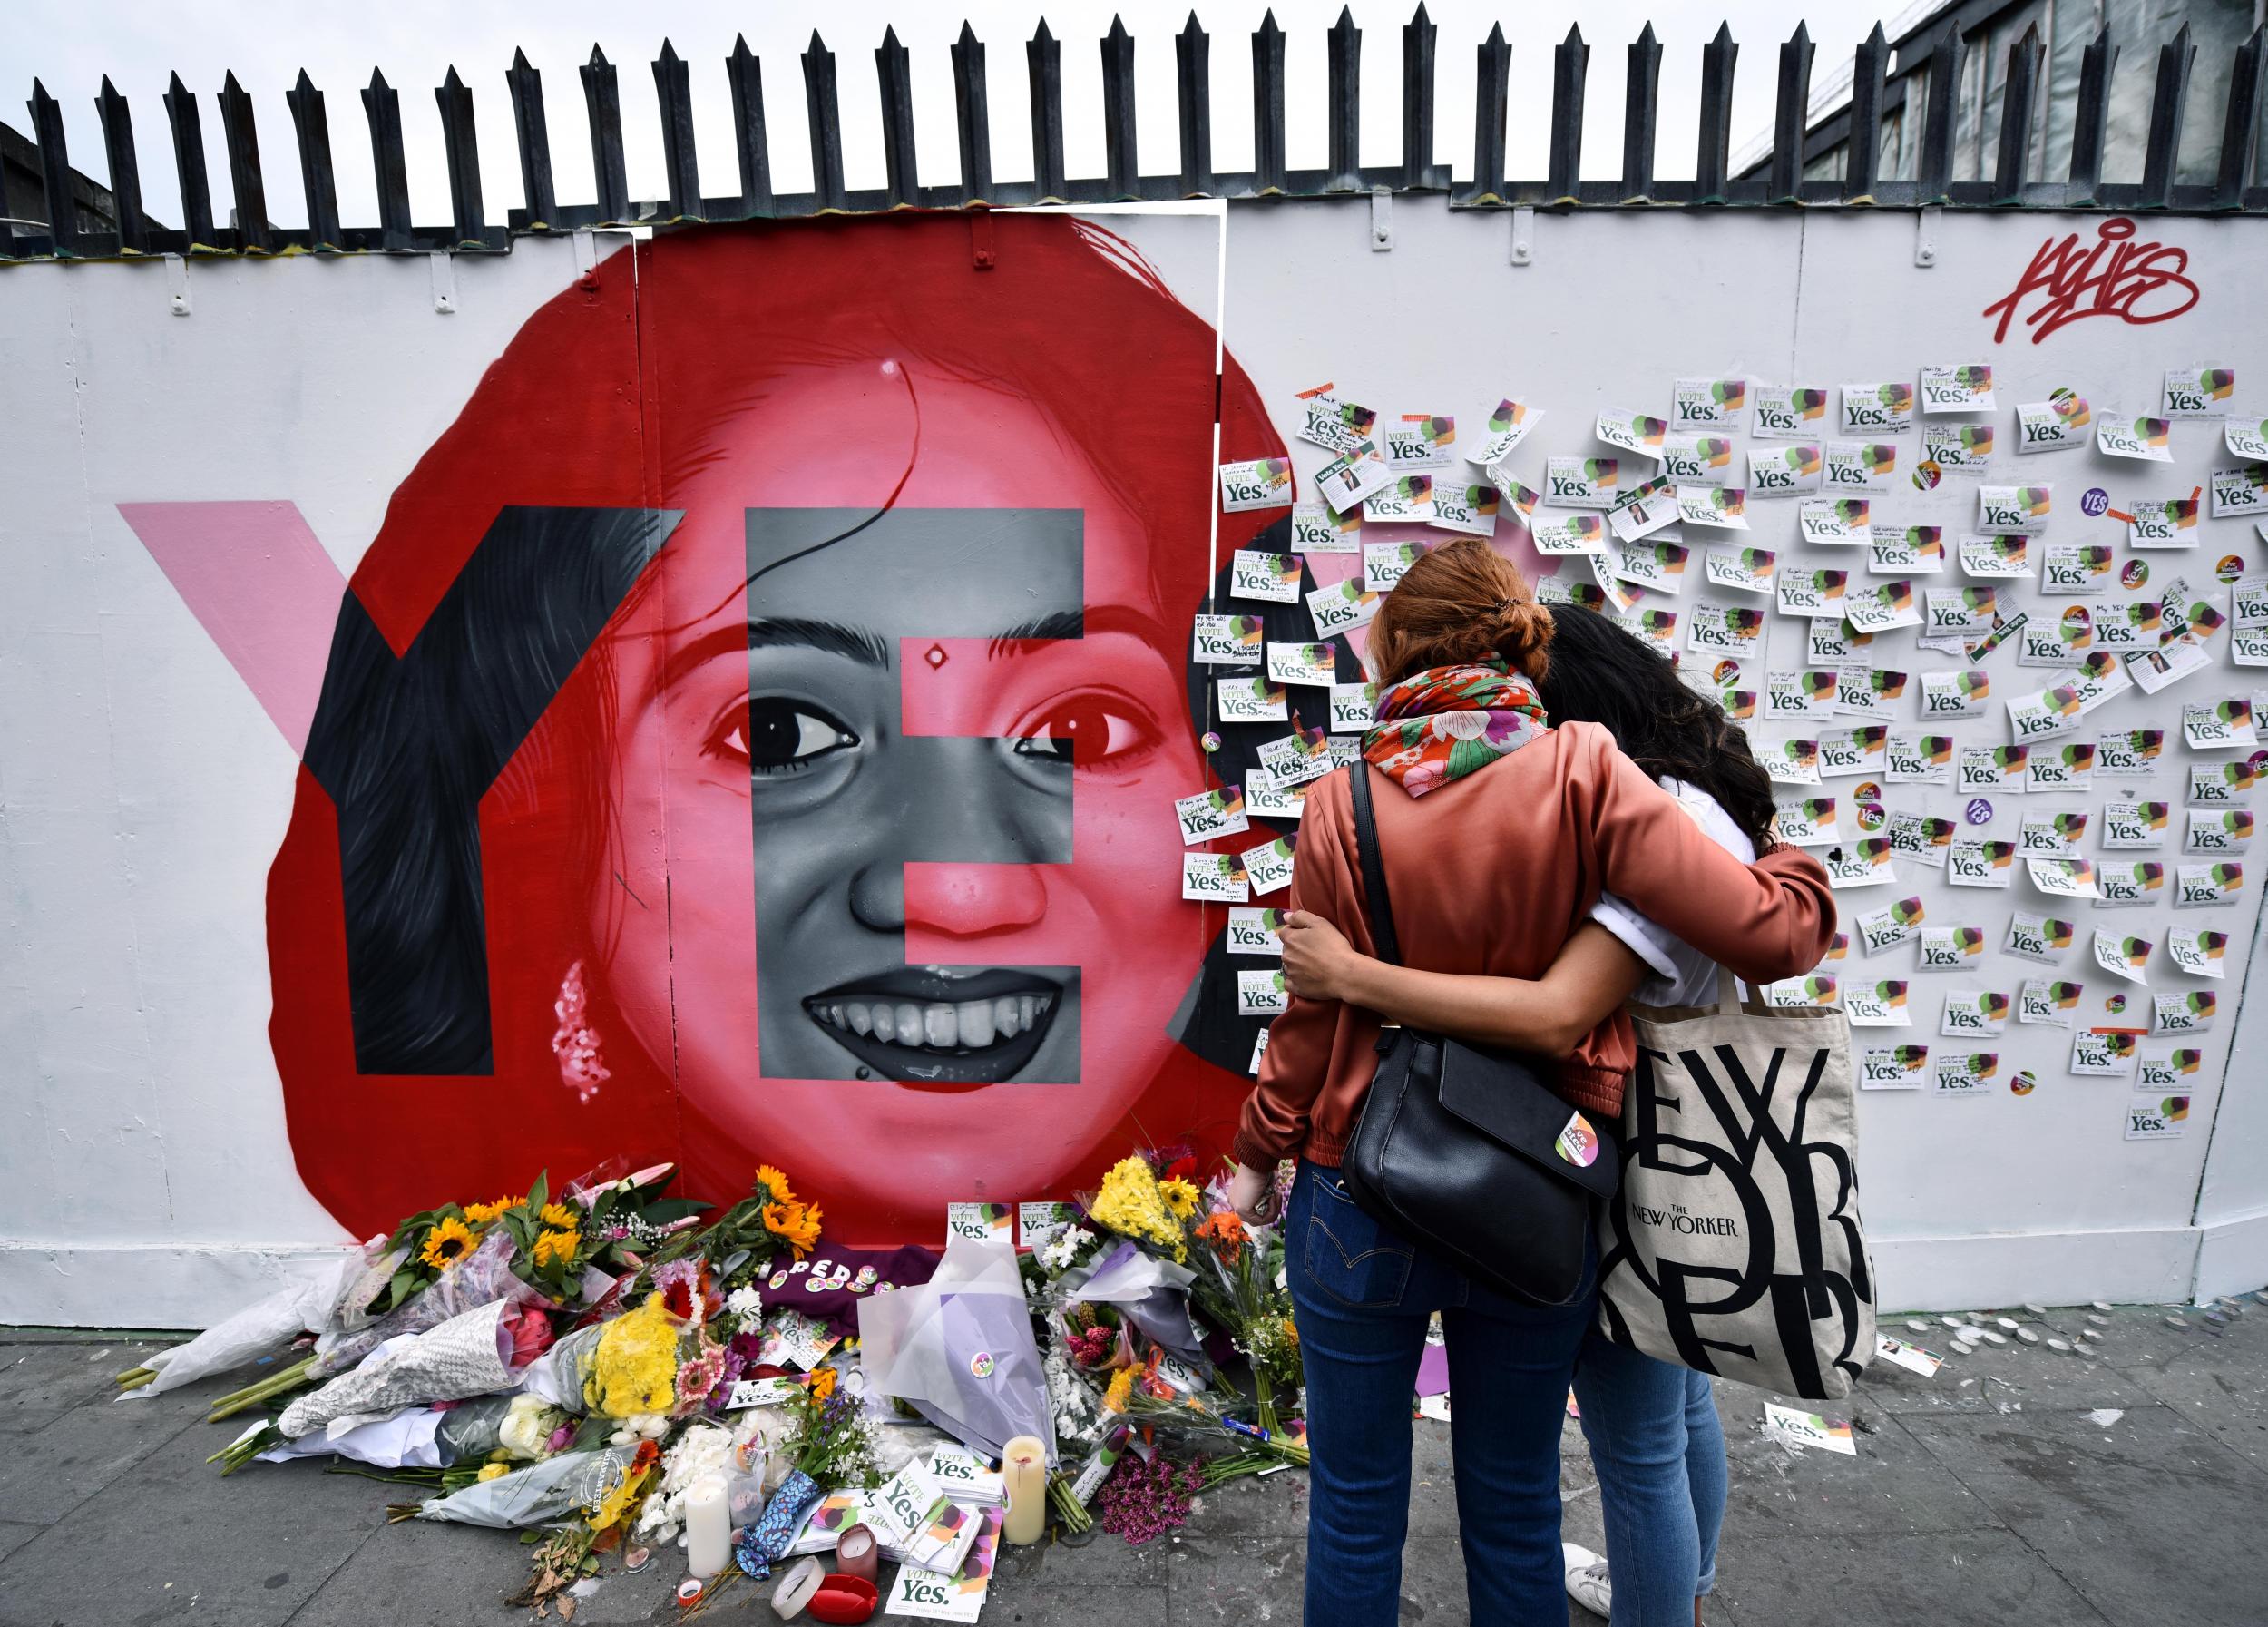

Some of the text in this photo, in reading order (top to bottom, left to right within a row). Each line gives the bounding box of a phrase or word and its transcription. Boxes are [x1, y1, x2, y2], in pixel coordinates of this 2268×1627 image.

[1678, 392, 1705, 401] VOTE
[1924, 386, 1970, 403] Yes.
[2168, 392, 2206, 410] Yes.
[1678, 401, 1719, 420] Yes.
[1759, 400, 1784, 409] VOTE
[1758, 410, 1797, 429] Yes.
[1847, 407, 1888, 426] Yes.
[1389, 432, 1415, 442] VOTE
[1599, 424, 1638, 448] Yes.
[2024, 423, 2065, 442] Yes.
[1389, 441, 1431, 460] Yes.
[1664, 446, 1690, 456] VOTE
[2102, 434, 2145, 452] Yes.
[1926, 445, 1966, 465] Yes.
[1318, 461, 1348, 482] Vote Yes.
[1552, 469, 1578, 477] VOTE
[1664, 456, 1704, 476] Yes.
[1828, 464, 1868, 484] Yes.
[1551, 477, 1591, 497] Yes.
[1754, 469, 1795, 488] Yes.
[2215, 479, 2242, 488] VOTE
[1226, 480, 1267, 501] Yes.
[2215, 488, 2257, 505] Yes.
[1364, 499, 1408, 515] Yes.
[1433, 500, 1471, 523] Yes.
[2084, 494, 2107, 513] YES
[1295, 515, 1321, 524] VOTE
[1985, 507, 2024, 526] Yes.
[1295, 524, 1335, 544] Yes.
[1804, 518, 1846, 535] Yes.
[2135, 522, 2173, 538] Yes.
[1873, 546, 1915, 564] Yes.
[1621, 554, 1658, 579] Yes.
[2048, 566, 2086, 584] Yes.
[1780, 589, 1820, 607] Yes.
[1315, 604, 1358, 628] Yes.
[1932, 608, 1971, 626] Yes.
[2097, 615, 2122, 624] VOTE
[1198, 628, 1222, 636] VOTE
[1693, 624, 1729, 645] Yes.
[2096, 624, 2135, 642] Yes.
[1198, 637, 1237, 653] Yes.
[1813, 637, 1847, 655] Yes.
[2027, 640, 2065, 658] Yes.
[1271, 662, 1312, 679] Yes.
[1771, 682, 1795, 691] VOTE
[2077, 682, 2104, 703] es.
[1770, 691, 1808, 710] Yes.
[1838, 686, 1874, 707] Yes.
[1928, 693, 1965, 711] Yes.
[2015, 715, 2059, 735] Yes.
[2186, 724, 2231, 740] Yes.
[1821, 749, 1862, 766] Yes.
[1890, 757, 1924, 773] Yes.
[1963, 757, 1988, 766] VOTE
[2030, 756, 2056, 764] VOTE
[2099, 750, 2136, 768] Yes.
[1963, 766, 1999, 784] Yes.
[2030, 763, 2068, 781] Yes.
[2194, 783, 2229, 800] Yes.
[1967, 800, 1990, 823] YES
[2024, 831, 2060, 849] Yes.
[2109, 823, 2145, 839] Yes.
[2193, 831, 2228, 848] Yes.
[1952, 850, 1976, 859] VOTE
[1251, 862, 1293, 886] Yes.
[1951, 859, 1988, 876] Yes.
[1187, 873, 1225, 891] Yes.
[2104, 884, 2138, 898] Yes.
[2183, 886, 2218, 901] Yes.
[1231, 928, 1269, 945] Yes.
[1867, 927, 1905, 949] Yes.
[2011, 933, 2043, 953] Yes.
[1924, 948, 1959, 965] Yes.
[2173, 947, 2204, 966] Yes.
[1243, 992, 1282, 1008] Yes.
[1848, 1001, 1886, 1017] Yes.
[2023, 997, 2051, 1016] Yes.
[1948, 1011, 1982, 1028] Yes.
[2160, 1014, 2193, 1029] Yes.
[2077, 1050, 2110, 1065] Yes.
[1938, 1074, 1973, 1089] Yes.
[2143, 1068, 2175, 1083] Yes.
[2132, 1116, 2165, 1132] Yes.
[1670, 1203, 1689, 1215] THE
[1632, 1202, 1739, 1237] NEW YORKER
[936, 1452, 965, 1463] VOTE
[932, 1459, 974, 1480] Yes.
[592, 1448, 613, 1513] GUARANTEED
[907, 1570, 936, 1579] VOTE
[901, 1579, 949, 1604] Yes.
